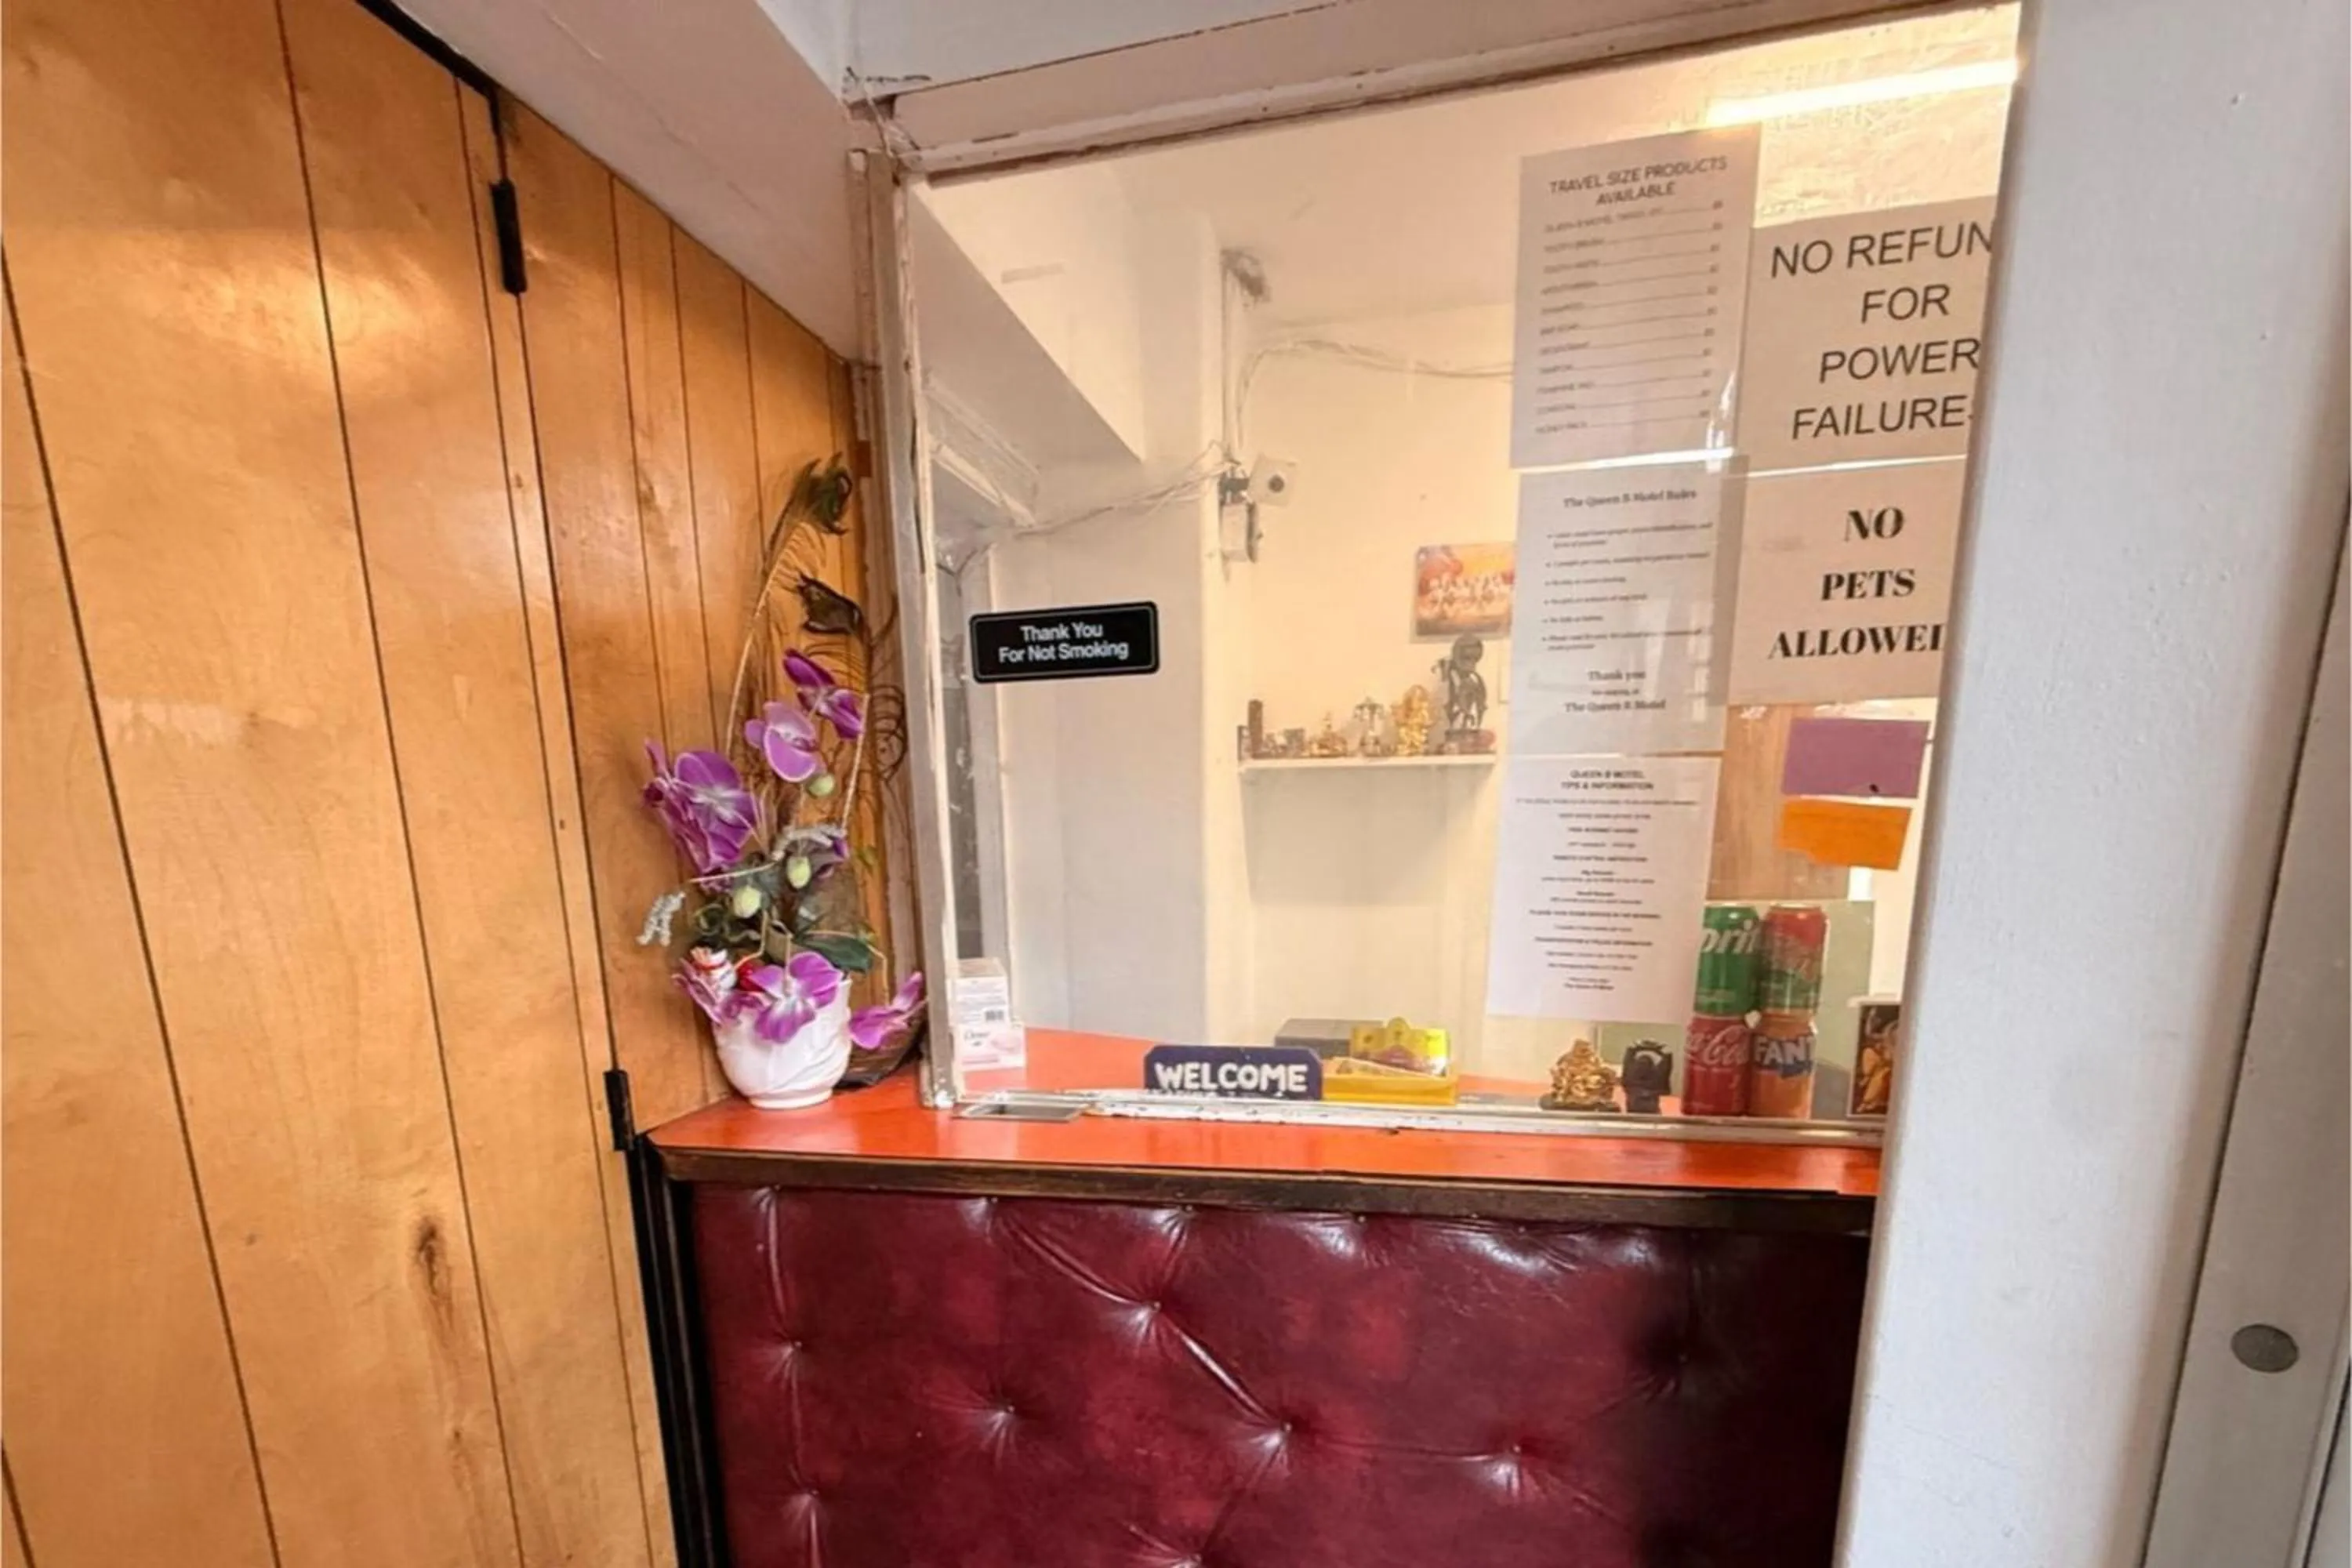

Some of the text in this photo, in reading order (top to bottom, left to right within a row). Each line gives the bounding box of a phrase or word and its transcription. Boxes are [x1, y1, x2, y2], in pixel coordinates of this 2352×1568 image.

[1548, 155, 1728, 194] TRAVEL SIZE PRODUCTS
[1595, 180, 1676, 206] AVAILABLE
[1770, 240, 1833, 278] NO
[1860, 283, 1951, 324] FOR
[1818, 337, 1982, 384] POWER
[1792, 394, 1973, 440] FAILURE
[1844, 506, 1905, 543] NO
[1820, 568, 1916, 601] PETS
[1020, 622, 1103, 643] Thank You
[998, 640, 1129, 663] For Not Smoking
[1153, 1061, 1308, 1092] WELCOME
